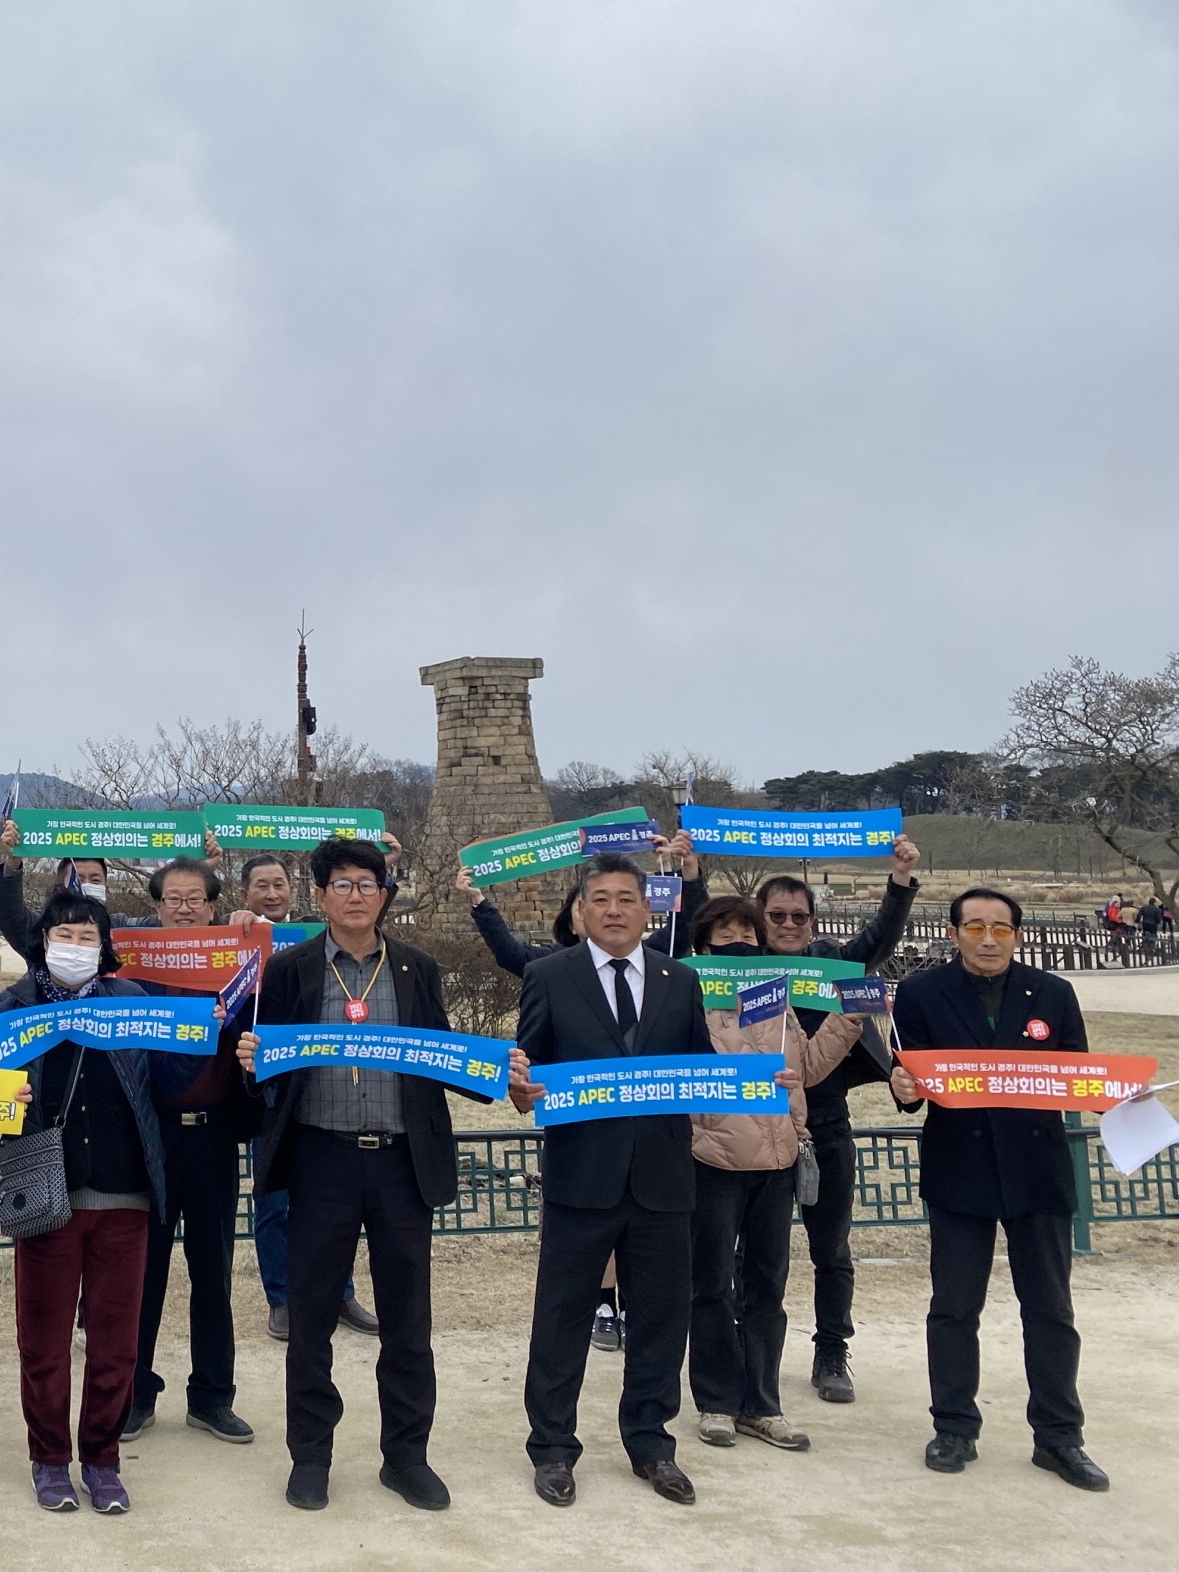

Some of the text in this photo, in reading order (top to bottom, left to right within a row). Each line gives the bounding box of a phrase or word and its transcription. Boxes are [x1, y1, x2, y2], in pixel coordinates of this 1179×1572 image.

[23, 832, 201, 848] 2025 APEC 정상회의는 경주에서!
[214, 825, 242, 837] 2025
[245, 825, 276, 838] APEC
[279, 826, 332, 840] 정상회의는
[588, 835, 608, 843] 2025
[609, 833, 631, 842] APEC
[690, 828, 895, 847] 2025 APEC 정상회의 최적지는 경주!
[473, 861, 502, 876] 2025
[505, 853, 537, 870] APEC
[654, 887, 671, 897] 경주
[133, 938, 239, 949] 도시 경주! 대한민국을 넘어 세계로!
[141, 952, 207, 970] 정상회의는
[743, 1001, 757, 1012] 2025
[756, 993, 772, 1007] APEC
[777, 987, 786, 1000] 경주
[19, 1022, 54, 1048] APEC
[58, 1018, 112, 1039] 정상회의
[115, 1021, 171, 1039] 최적지는
[176, 1024, 209, 1043] 경주!
[263, 1044, 500, 1082] 2025 APEC 정상회의 최적지는 경주!
[571, 1068, 737, 1085] 가장 한국적인 도시 경주! 대한민국을 넘어 세계로!
[948, 1077, 984, 1093] APEC
[988, 1078, 1068, 1097] 정상회의는
[544, 1082, 776, 1111] 2025 APEC 정상회의 최적지는 경주!
